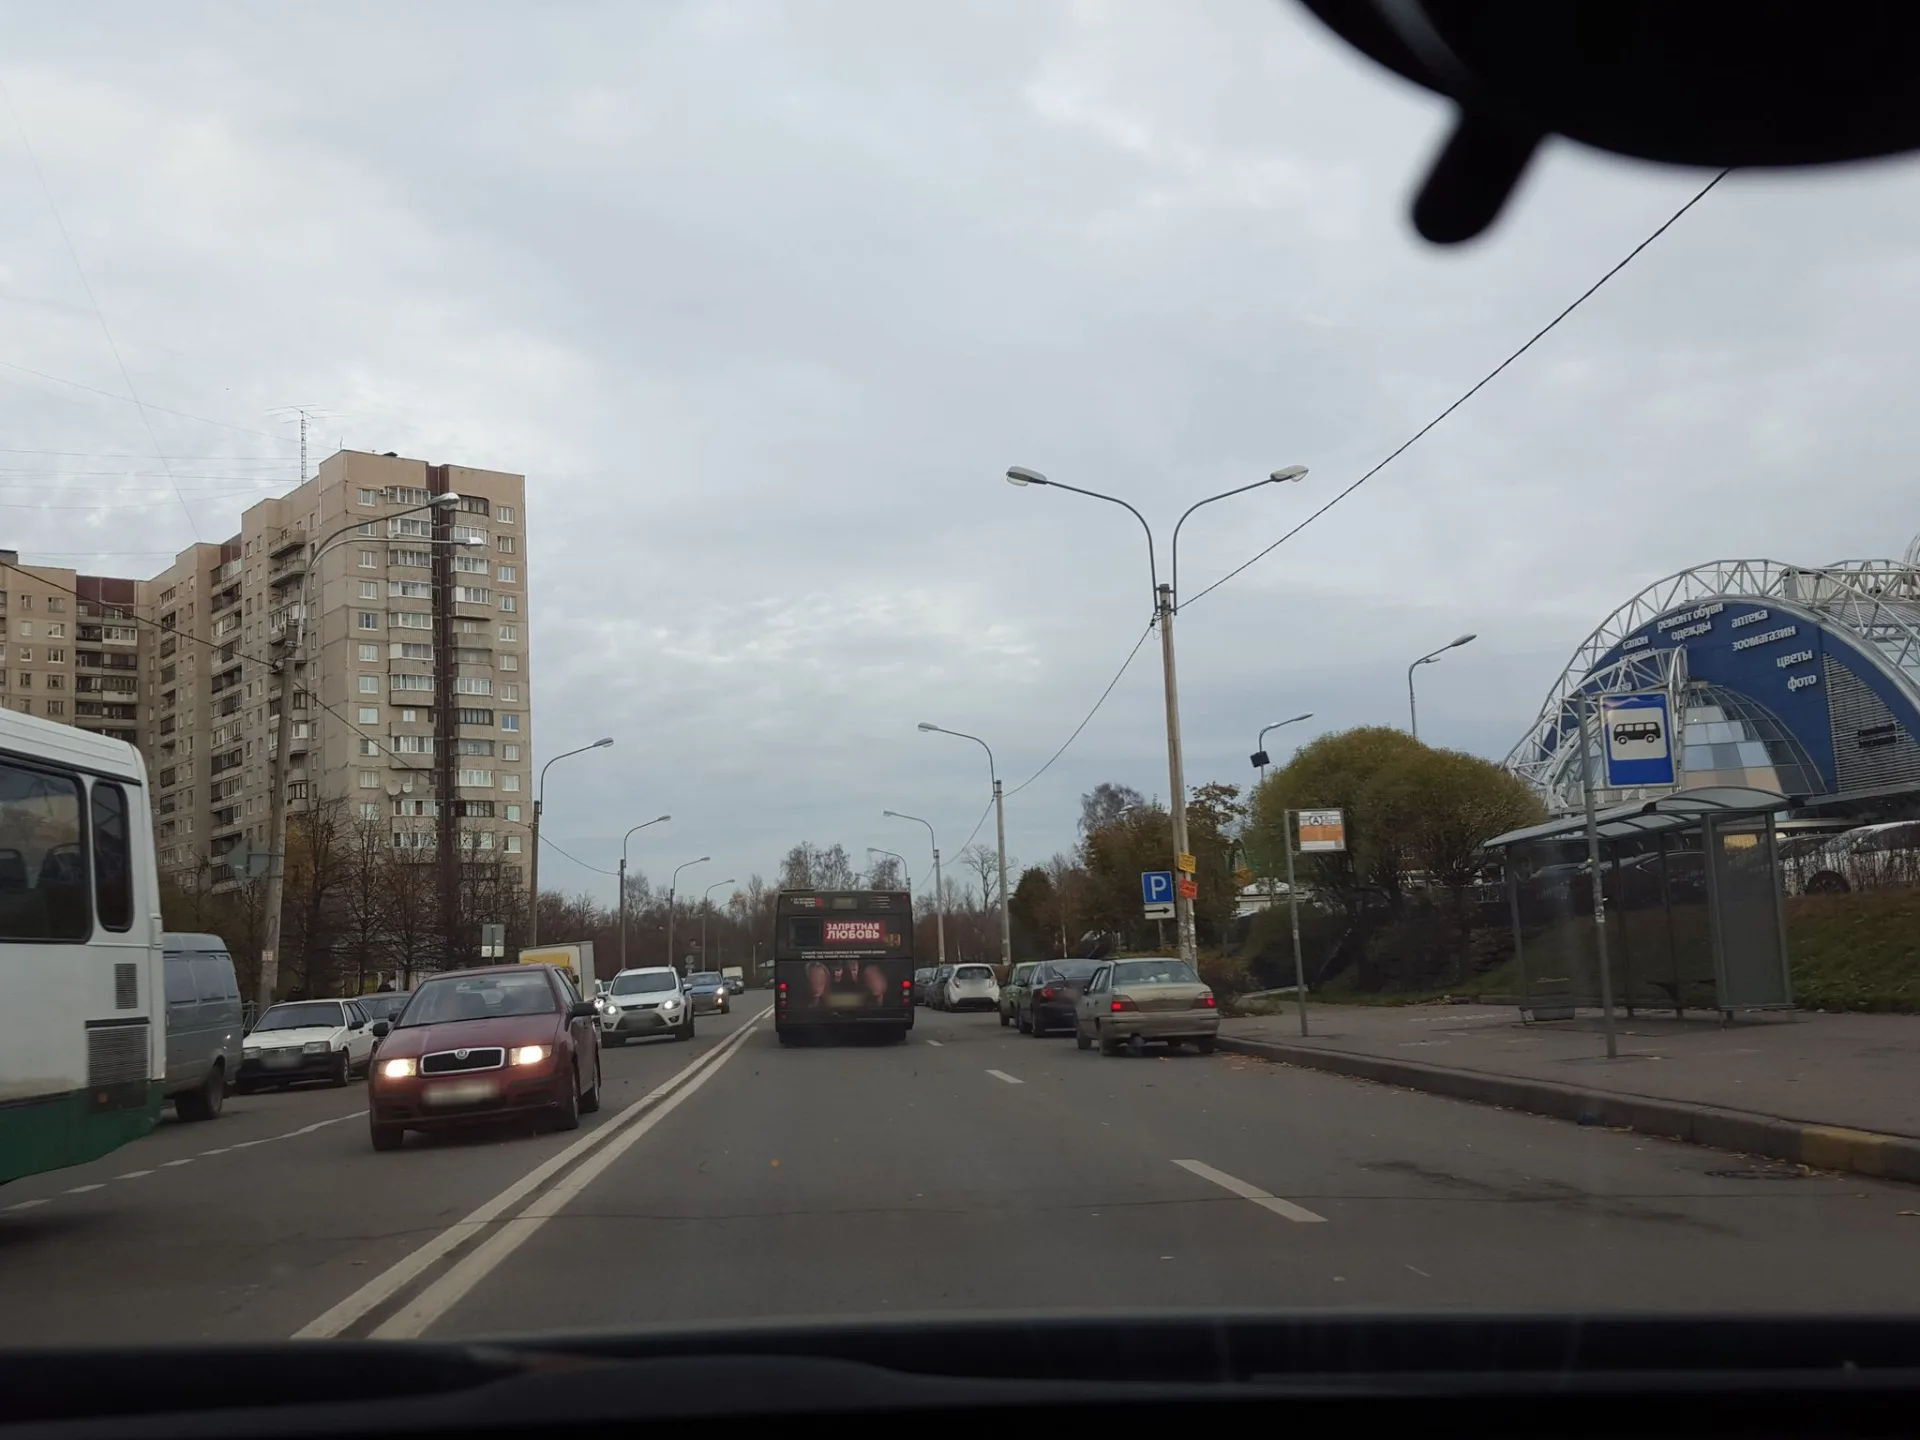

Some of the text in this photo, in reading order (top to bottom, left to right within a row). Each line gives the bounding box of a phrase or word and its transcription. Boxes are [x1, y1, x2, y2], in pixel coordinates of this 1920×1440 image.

[1657, 602, 1724, 634] ремонт обуви
[1731, 609, 1768, 628] аптека
[1671, 621, 1712, 641] одежды
[1732, 625, 1797, 651] зоомагазин
[1622, 635, 1649, 650] салон
[1776, 649, 1813, 668] цветы
[1787, 674, 1817, 692] фото
[1150, 875, 1167, 900] P
[826, 922, 880, 931] ЗАПРЕТНАЯ
[826, 930, 880, 939] ЛЮБОВЬ
